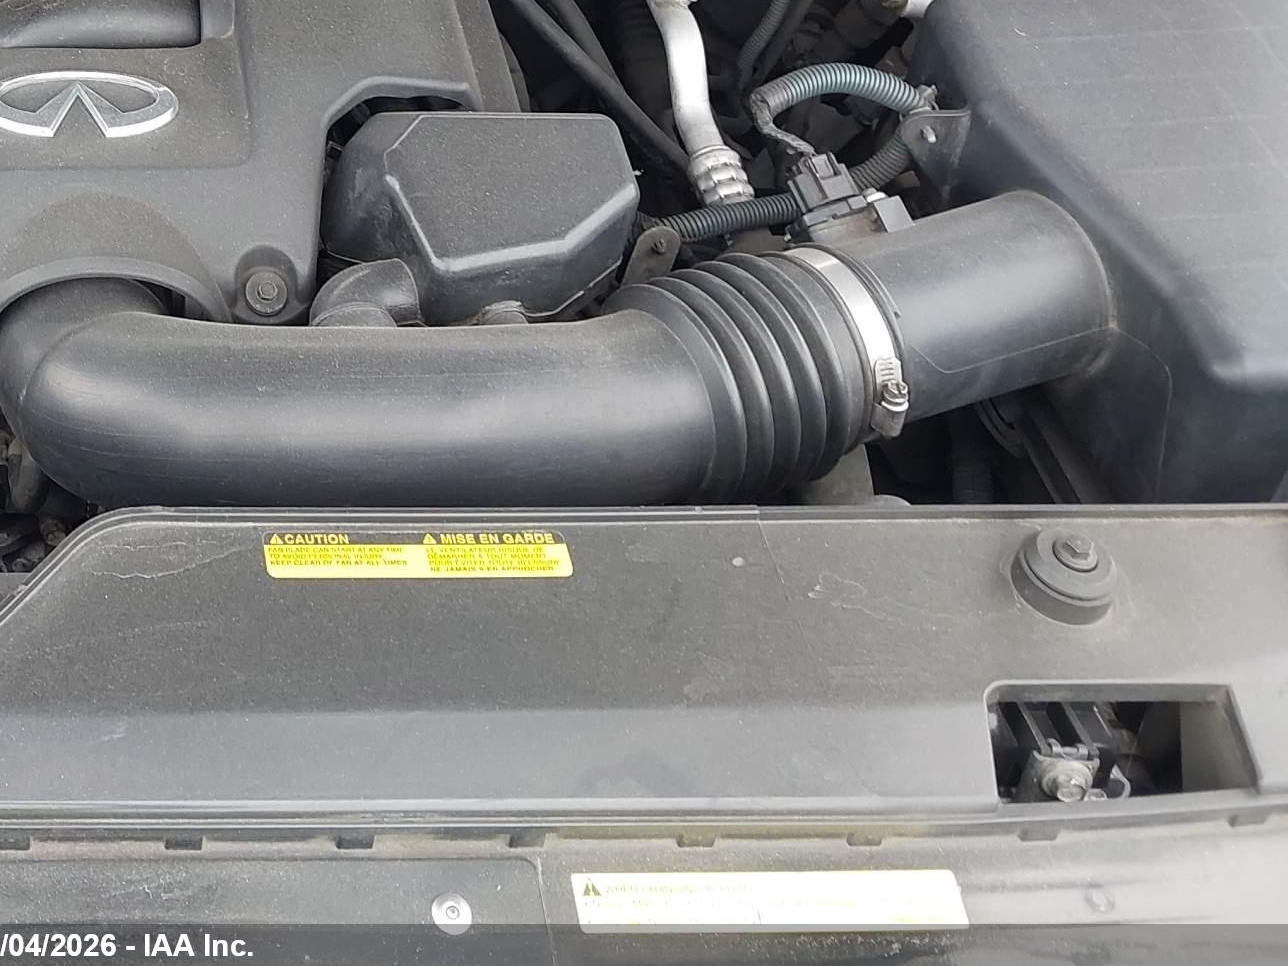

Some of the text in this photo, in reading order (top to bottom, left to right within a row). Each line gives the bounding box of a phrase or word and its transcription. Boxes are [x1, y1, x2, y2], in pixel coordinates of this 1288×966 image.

[284, 533, 349, 545] CAUTION
[440, 533, 555, 544] MISE EN GARDE
